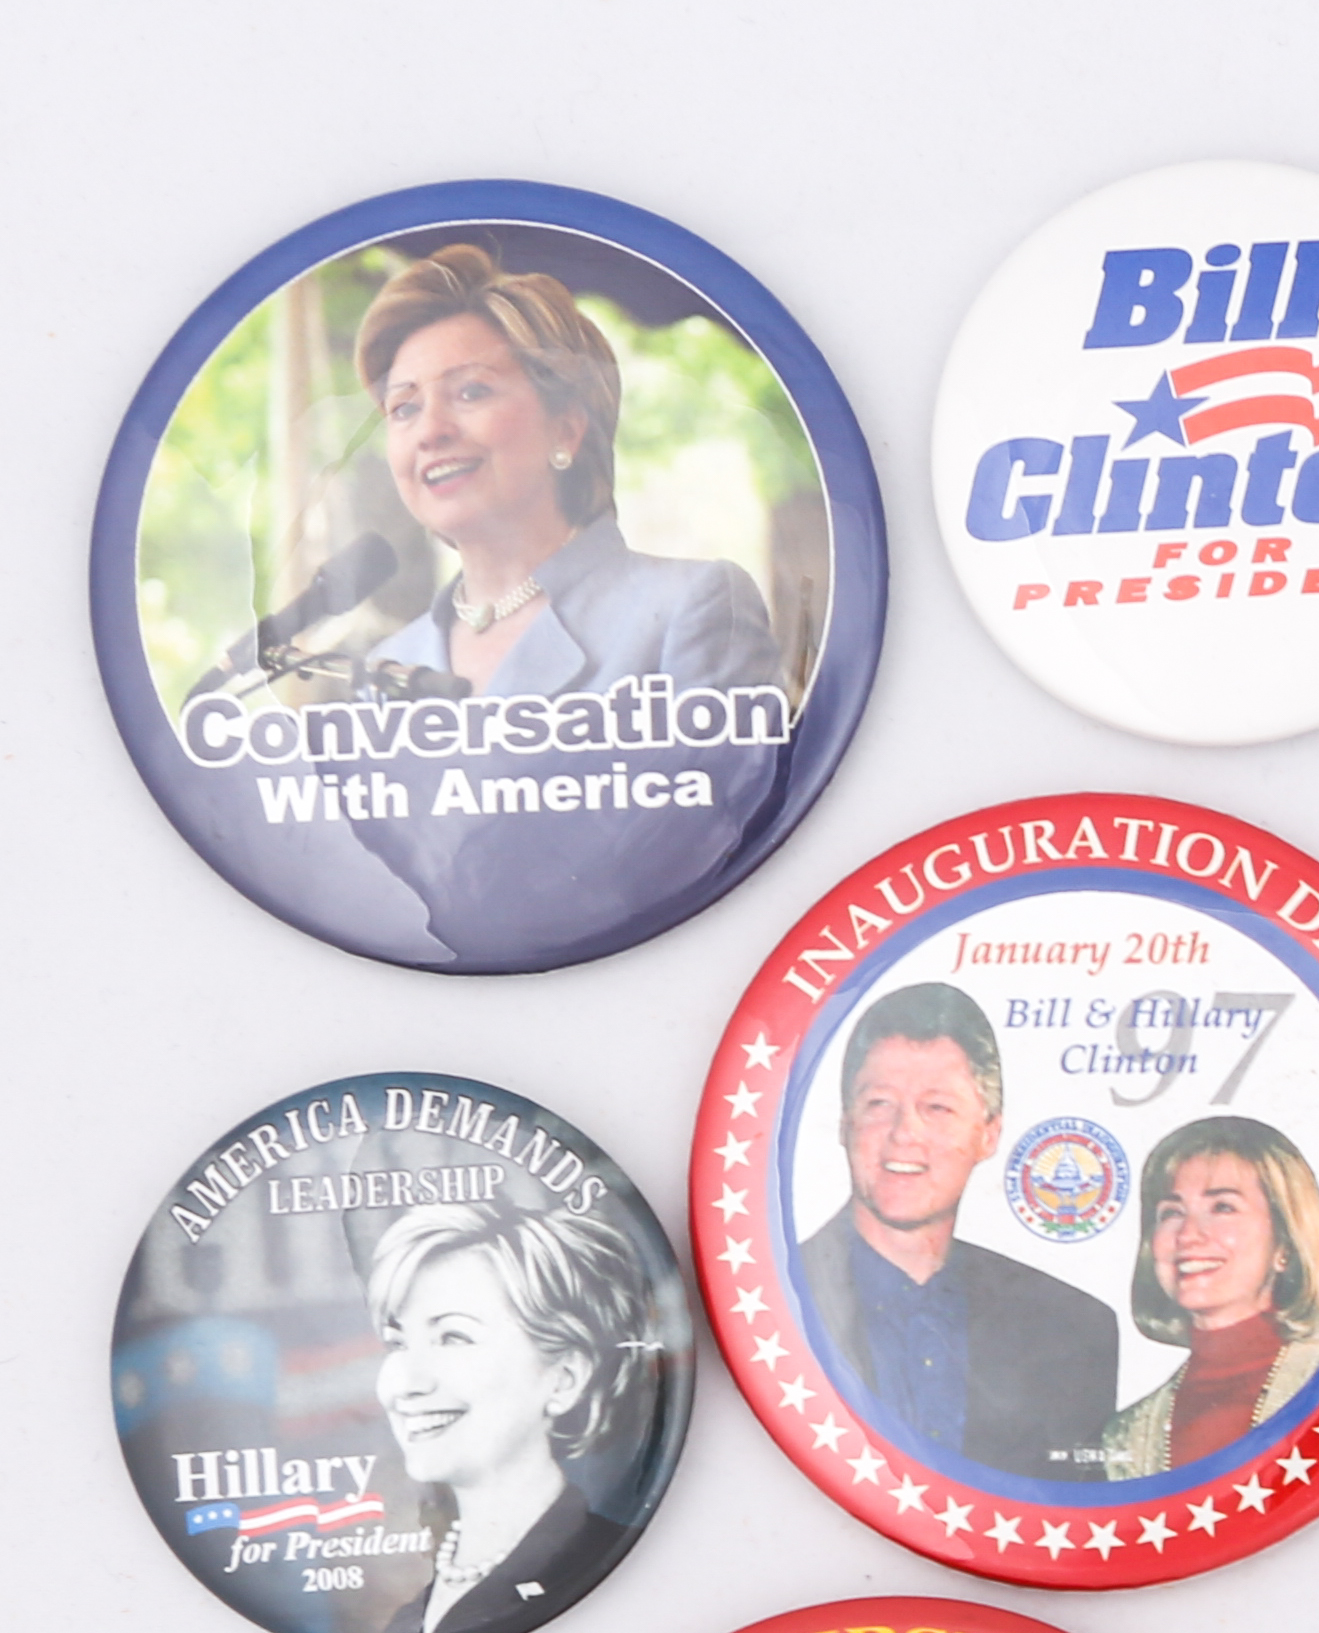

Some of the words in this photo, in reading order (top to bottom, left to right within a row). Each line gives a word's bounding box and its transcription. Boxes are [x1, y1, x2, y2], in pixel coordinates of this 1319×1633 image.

[1152, 537, 1293, 569] FOR
[180, 674, 793, 767] Conversation
[256, 775, 410, 824] With
[431, 762, 714, 817] America
[782, 815, 1280, 1004] INAUGURATION
[951, 932, 1112, 976] January
[1122, 931, 1211, 965] 20th
[1004, 997, 1072, 1028] Bill
[1085, 1000, 1116, 1028] &
[1129, 997, 1265, 1039] Hillary
[1059, 1044, 1198, 1074] Clinton
[1109, 989, 1296, 1106] 97
[169, 1093, 368, 1245] AMERICA
[384, 1087, 608, 1215] DEMANDS
[268, 1164, 506, 1214] LEADERSHIP
[171, 1447, 378, 1503] Hillary
[224, 1535, 277, 1571] for
[284, 1526, 432, 1561] President
[302, 1567, 364, 1591] 2008
